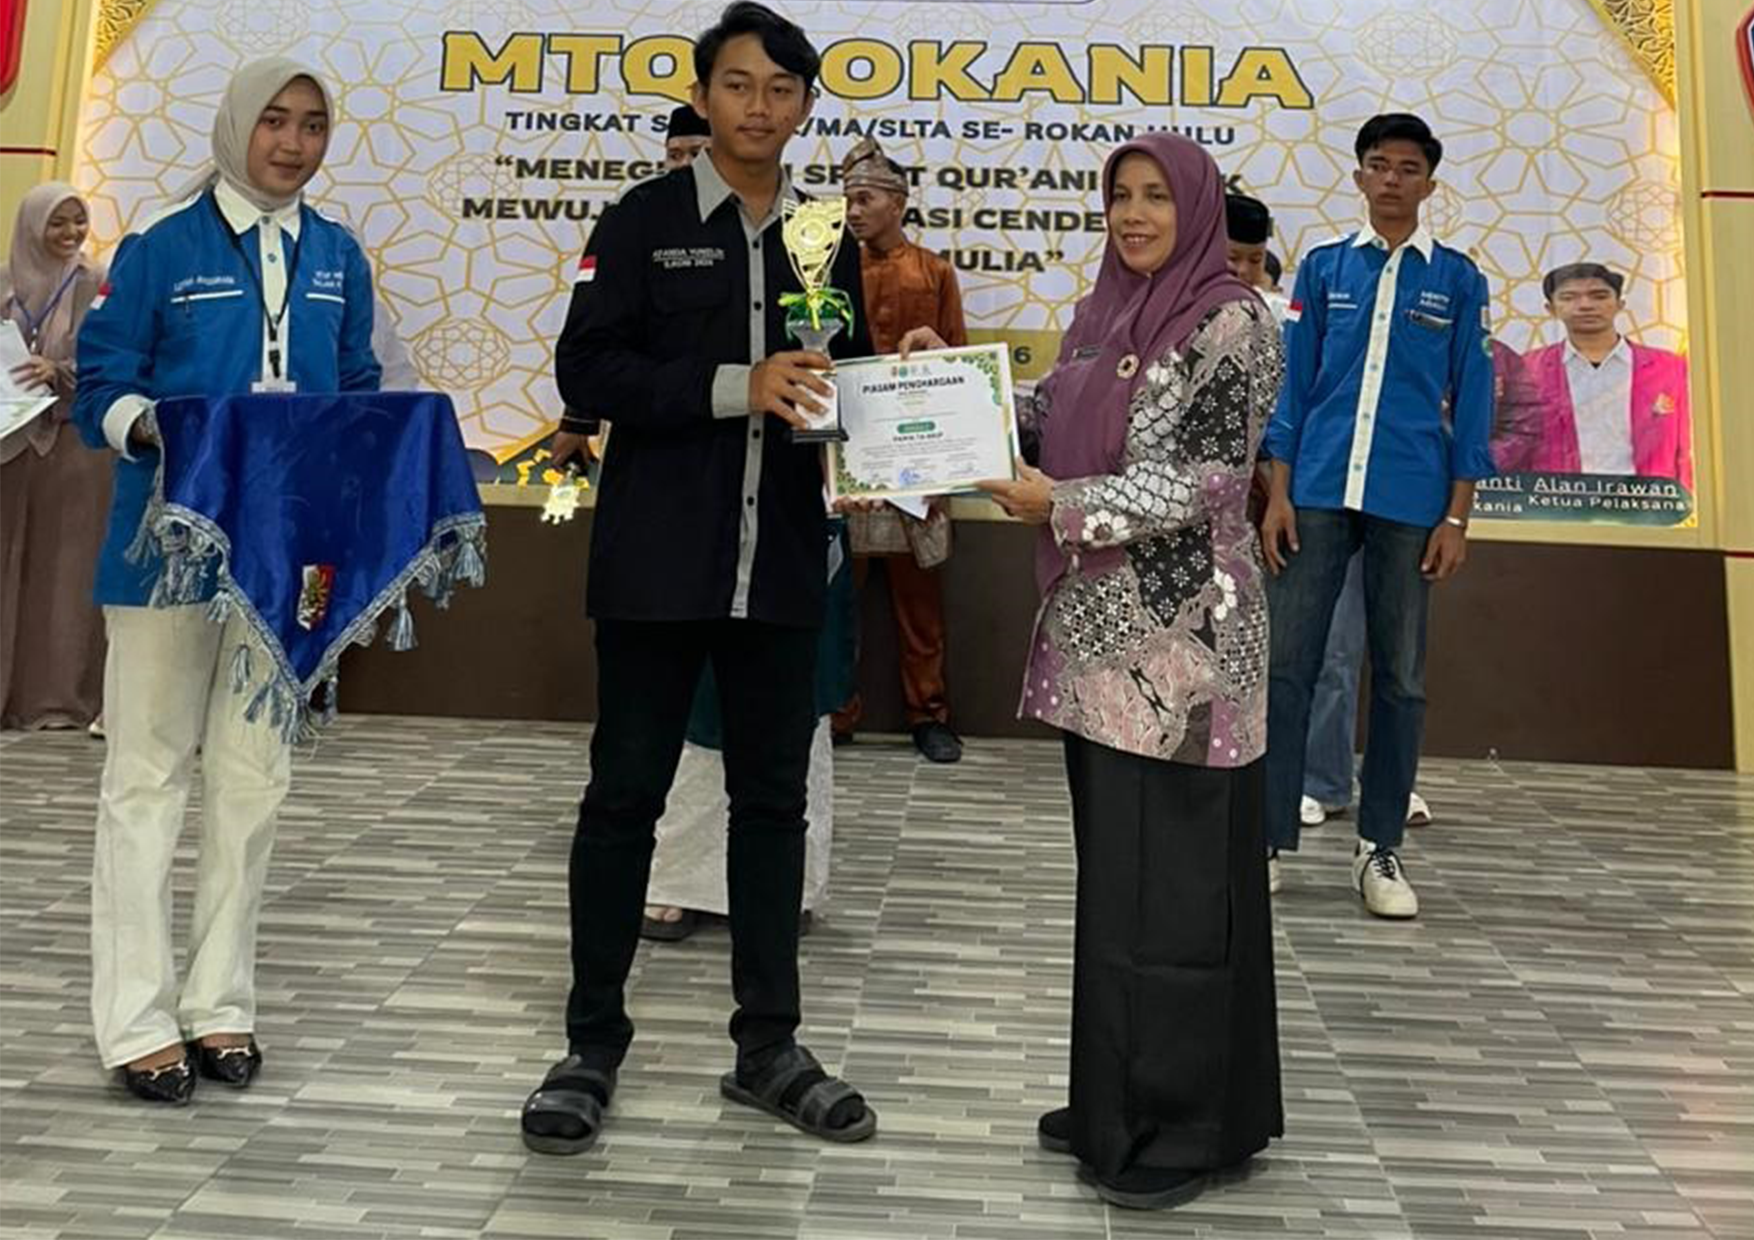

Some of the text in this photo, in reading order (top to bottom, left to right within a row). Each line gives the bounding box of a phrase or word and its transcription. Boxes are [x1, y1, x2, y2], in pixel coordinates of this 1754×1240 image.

[442, 32, 1314, 109] MTQ OKANIA
[505, 110, 641, 134] TINGKAT
[962, 121, 1014, 140] SE-
[1024, 121, 1134, 143] ROKAN
[1533, 477, 1586, 494] Alan
[1596, 479, 1678, 497] Irawan
[1528, 495, 1687, 512] Ketua Pelaksana
